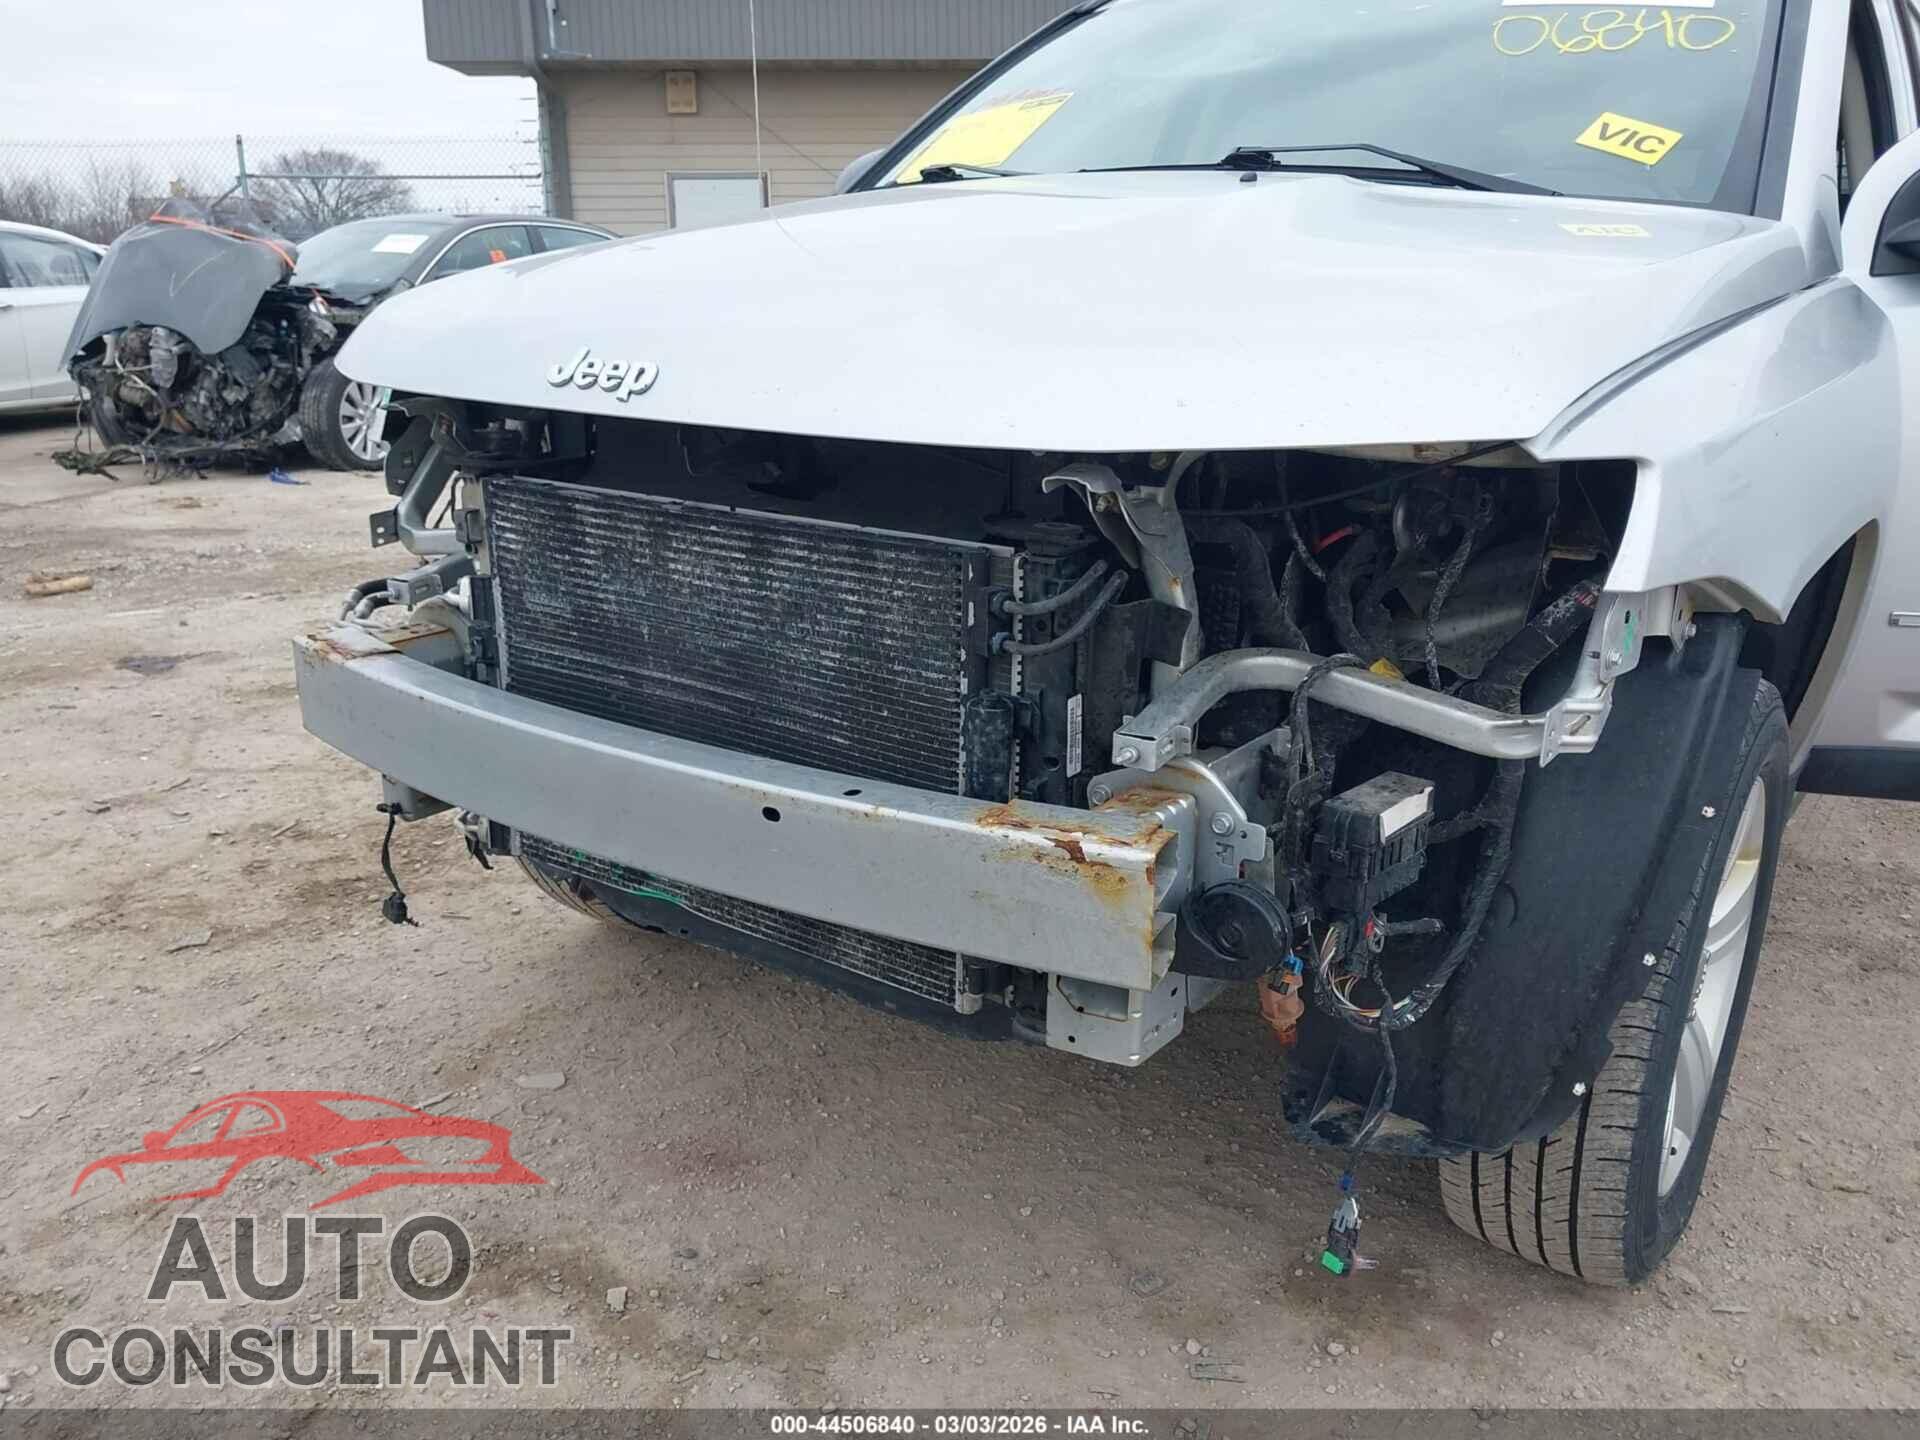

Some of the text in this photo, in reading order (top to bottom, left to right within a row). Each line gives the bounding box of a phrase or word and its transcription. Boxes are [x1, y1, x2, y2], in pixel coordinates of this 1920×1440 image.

[1493, 9, 1736, 56] 06840
[1597, 121, 1667, 155] VIC
[546, 345, 660, 403] Jeep
